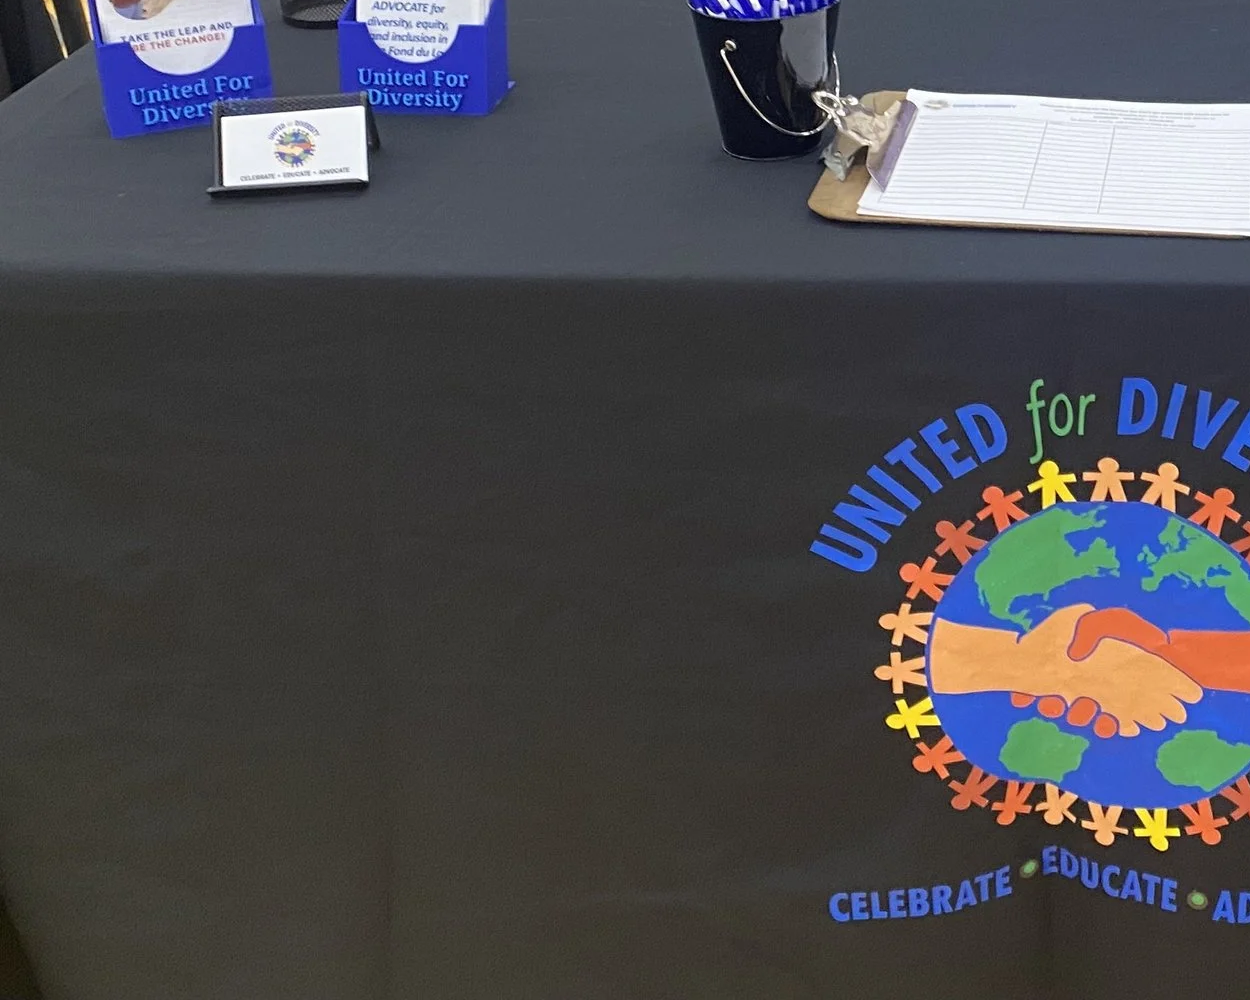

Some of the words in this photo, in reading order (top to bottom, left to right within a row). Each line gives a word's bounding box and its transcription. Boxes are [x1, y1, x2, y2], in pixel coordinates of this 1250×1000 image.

[372, 1, 428, 13] ADVOCATE
[430, 3, 446, 15] for
[120, 32, 150, 43] TAKE
[154, 29, 176, 40] THE
[178, 25, 207, 37] LEAP
[209, 21, 233, 33] AND
[367, 16, 412, 30] diversity,
[416, 20, 449, 31] equity,
[150, 39, 172, 50] THE
[175, 32, 226, 47] CHANGE!
[391, 32, 437, 43] inclusion
[438, 35, 448, 44] in
[388, 46, 414, 57] Fond
[416, 47, 430, 56] du
[357, 68, 427, 87] United
[433, 70, 469, 87] For
[129, 78, 208, 106] United
[214, 74, 253, 94] For
[366, 88, 464, 111] Diversity
[240, 173, 276, 182] CELEBRATE
[283, 170, 311, 178] EDUCATE
[319, 167, 350, 175] ADVOCATE
[808, 402, 1009, 573] UNITED
[1026, 379, 1096, 464] for
[828, 866, 1013, 922] CELEBRATE
[1042, 846, 1178, 912] EDUCATE
